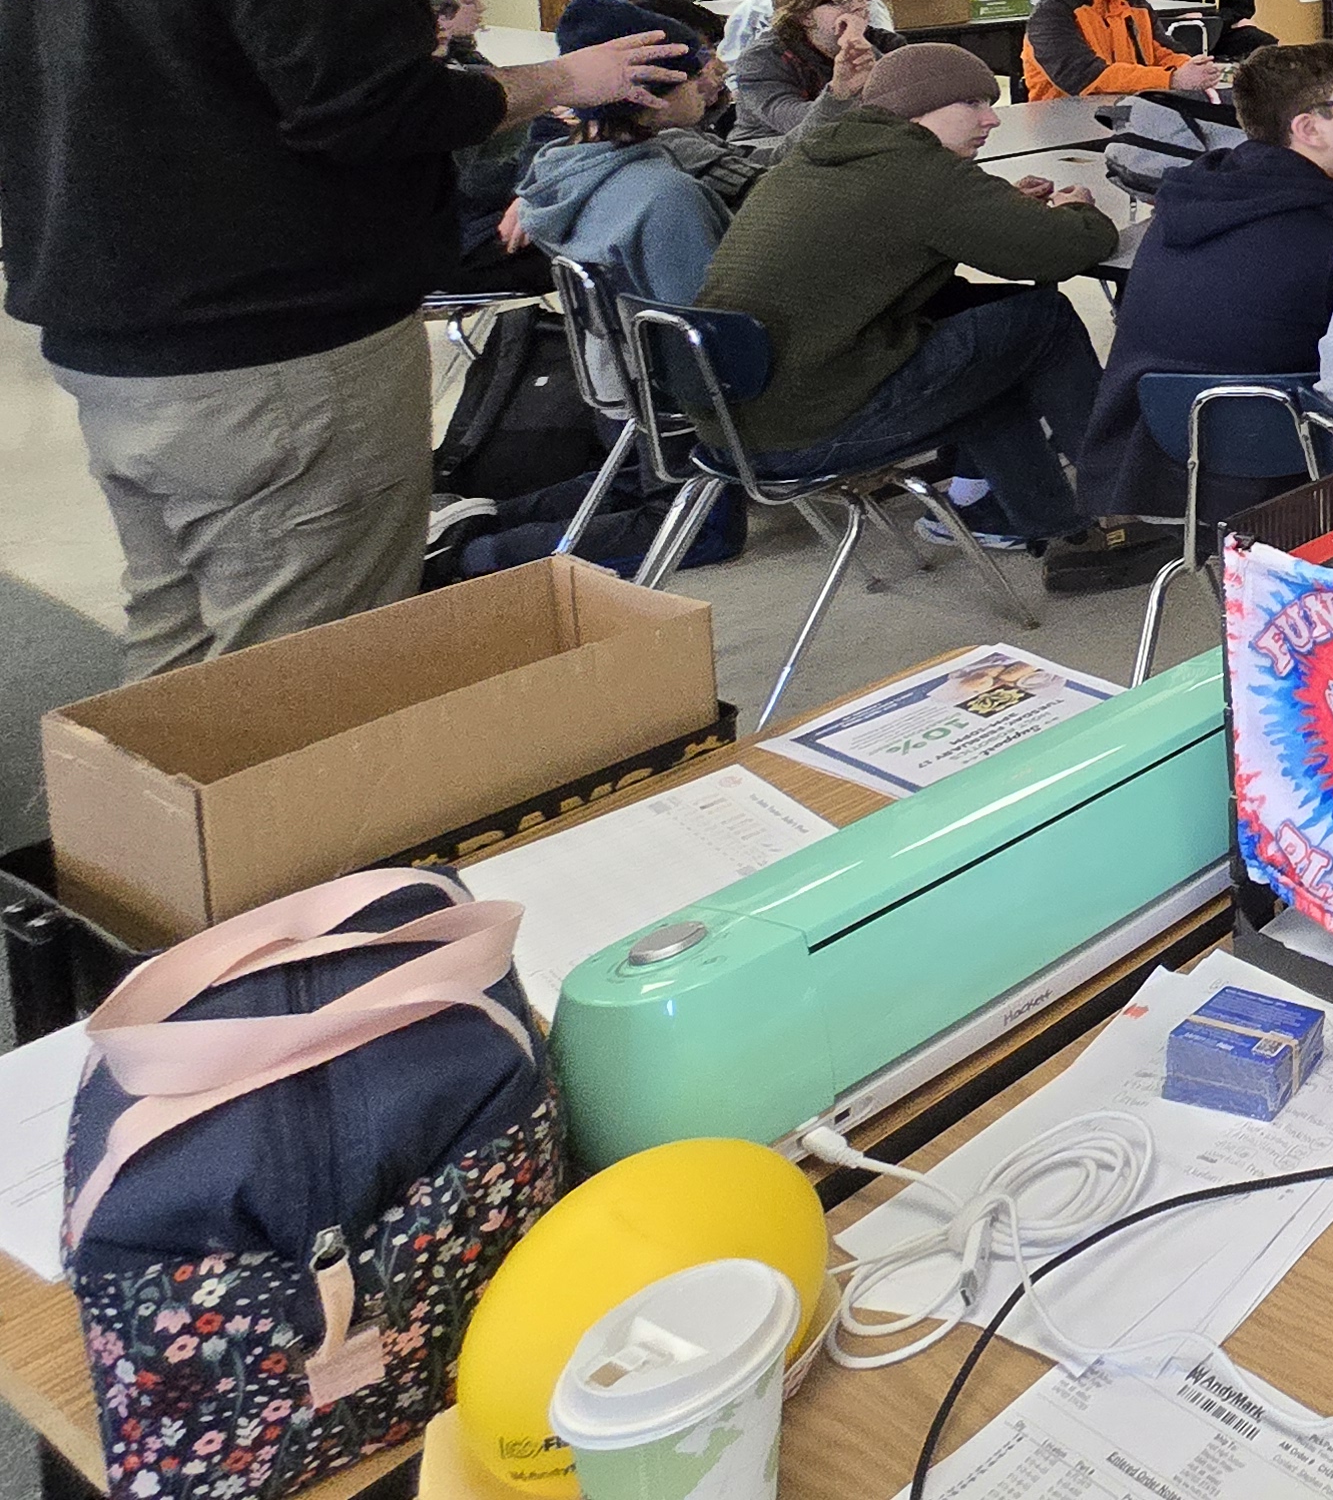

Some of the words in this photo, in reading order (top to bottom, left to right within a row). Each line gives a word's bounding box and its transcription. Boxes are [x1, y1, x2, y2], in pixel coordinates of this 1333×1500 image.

[884, 717, 971, 758] 10%
[1198, 1372, 1266, 1423] AndyMark
[1278, 1440, 1292, 1451] AM
[1289, 1446, 1308, 1463] Order
[1135, 1469, 1160, 1491] Order
